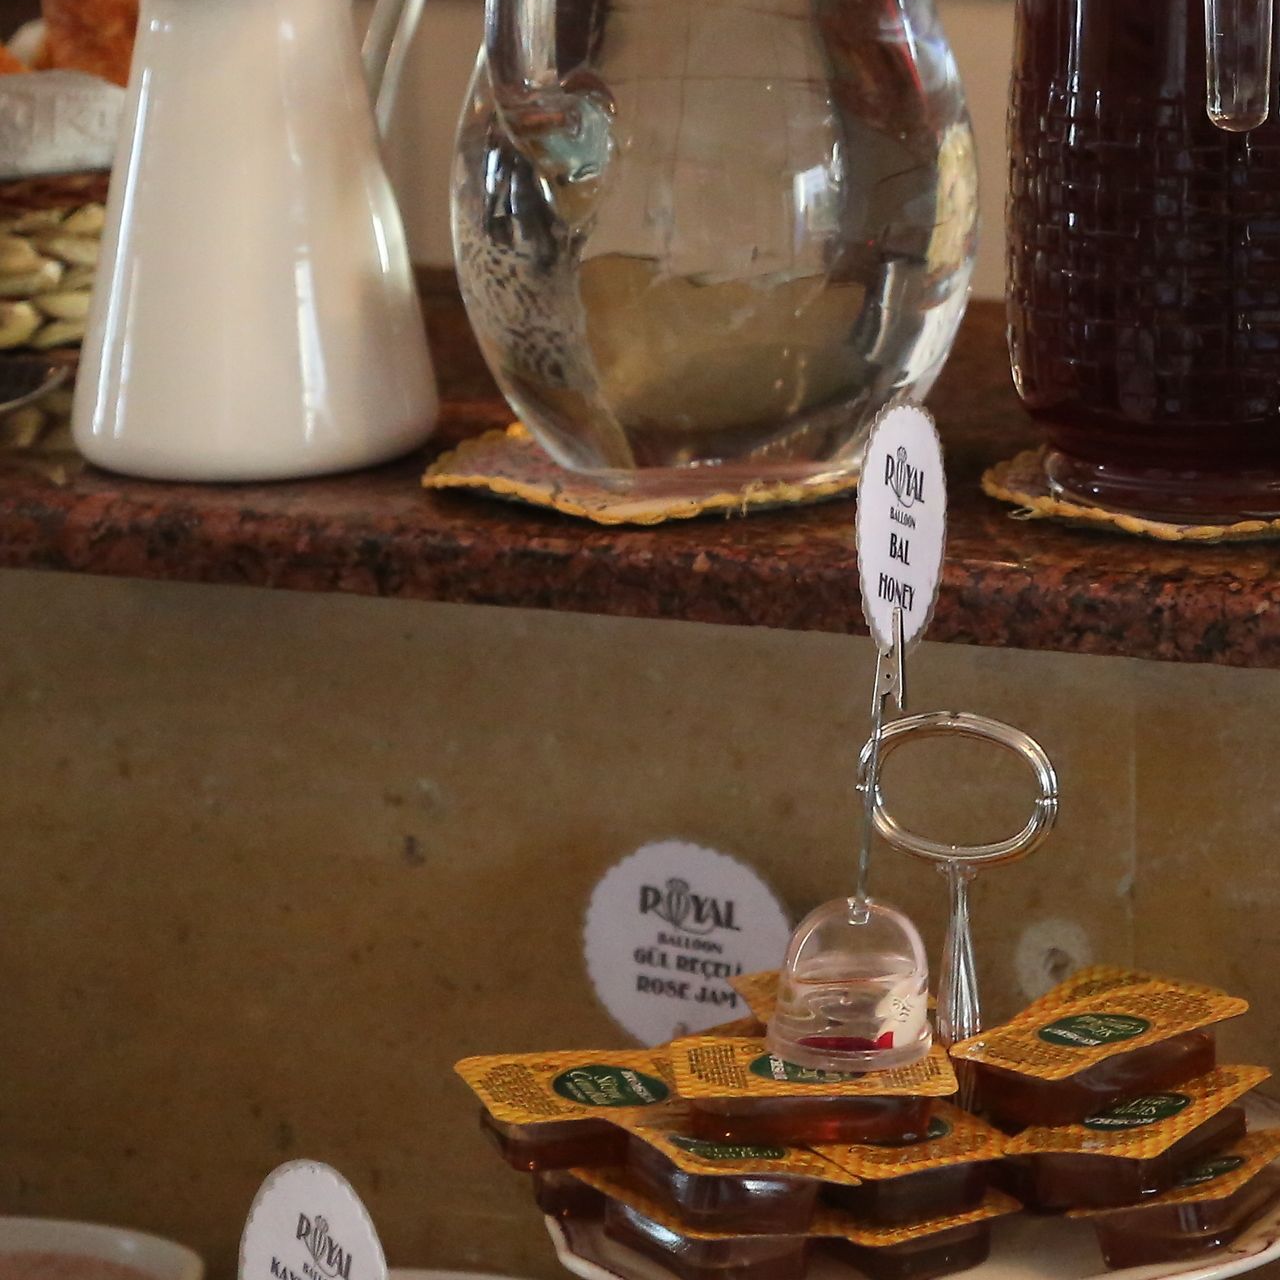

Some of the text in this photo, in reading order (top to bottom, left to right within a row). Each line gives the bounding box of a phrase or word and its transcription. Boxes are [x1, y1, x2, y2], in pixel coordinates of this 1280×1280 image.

[884, 448, 925, 504] ROYAL
[889, 506, 916, 531] BALLOON
[889, 532, 910, 566] BAL
[878, 572, 915, 612] HONEY
[638, 880, 740, 932] ROYAL
[658, 933, 723, 954] BALLOON
[636, 974, 737, 1010] ROSE JAM
